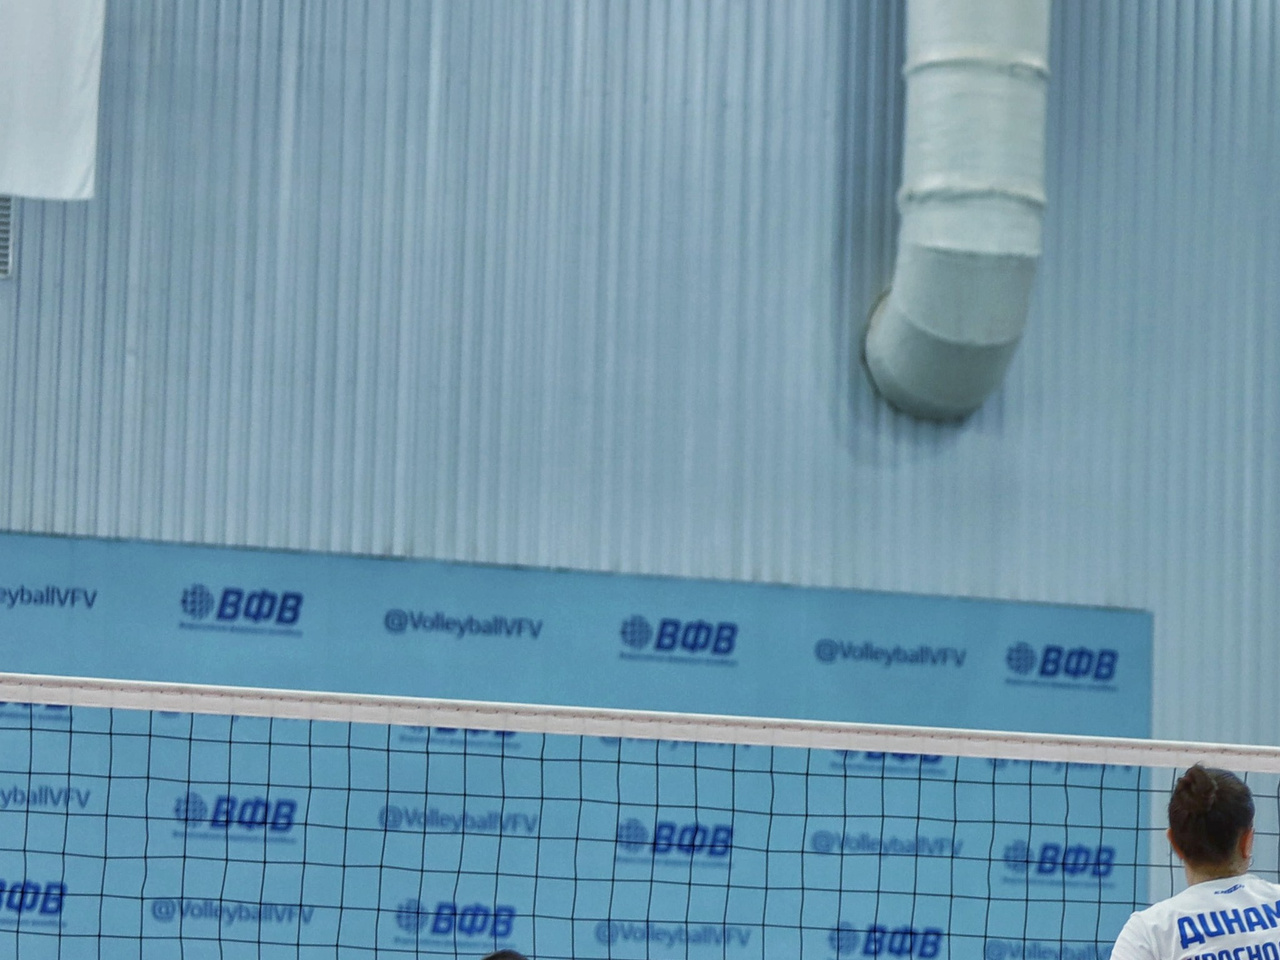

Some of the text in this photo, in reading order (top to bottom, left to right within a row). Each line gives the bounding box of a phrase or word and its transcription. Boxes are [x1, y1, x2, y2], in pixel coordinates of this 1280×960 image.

[216, 587, 304, 626] ВФВ
[384, 608, 543, 639] @VolleyballVFV
[654, 618, 739, 656] ВФВ
[815, 638, 966, 669] @VolleyballVFV
[1039, 645, 1118, 681] ВФВ
[209, 795, 298, 833] ВФВ
[379, 805, 538, 835] @VolleyballVFV
[653, 821, 734, 857] ВФВ
[811, 829, 963, 860] @VolleyballVFV
[1036, 842, 1116, 878] ВФВ
[0, 879, 67, 915] ФВ
[152, 899, 314, 927] @VolleyballVFV
[431, 901, 516, 939] ВФВ
[862, 924, 944, 960] ВФВ
